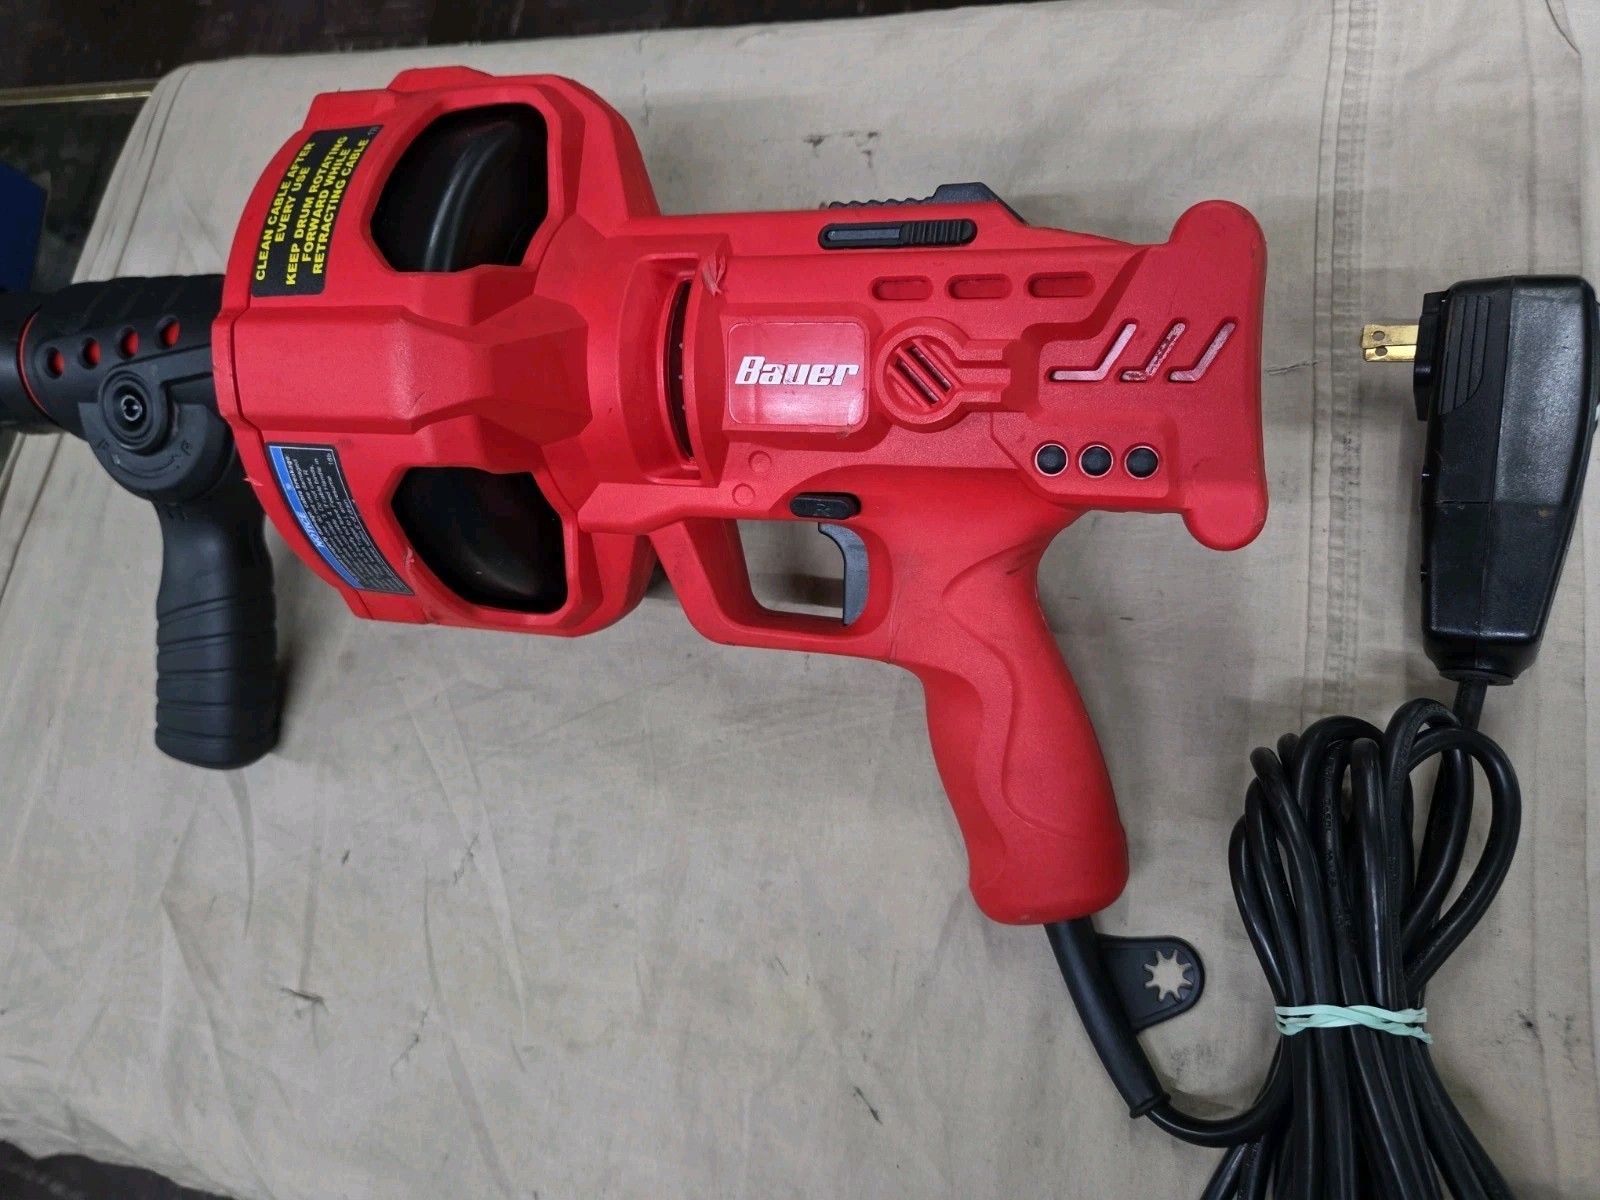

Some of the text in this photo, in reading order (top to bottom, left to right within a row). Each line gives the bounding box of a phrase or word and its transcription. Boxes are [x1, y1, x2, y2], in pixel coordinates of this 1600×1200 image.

[255, 142, 316, 281] CLEAN CABLE AFTER
[274, 166, 311, 242] EVERY USE
[286, 136, 348, 286] KEEP DRUM ROTATING
[301, 148, 351, 262] FORWARD WHILE
[312, 138, 369, 274] RETRACTING CABLE
[734, 355, 860, 386] Bauer
[296, 511, 326, 547] NOTICE
